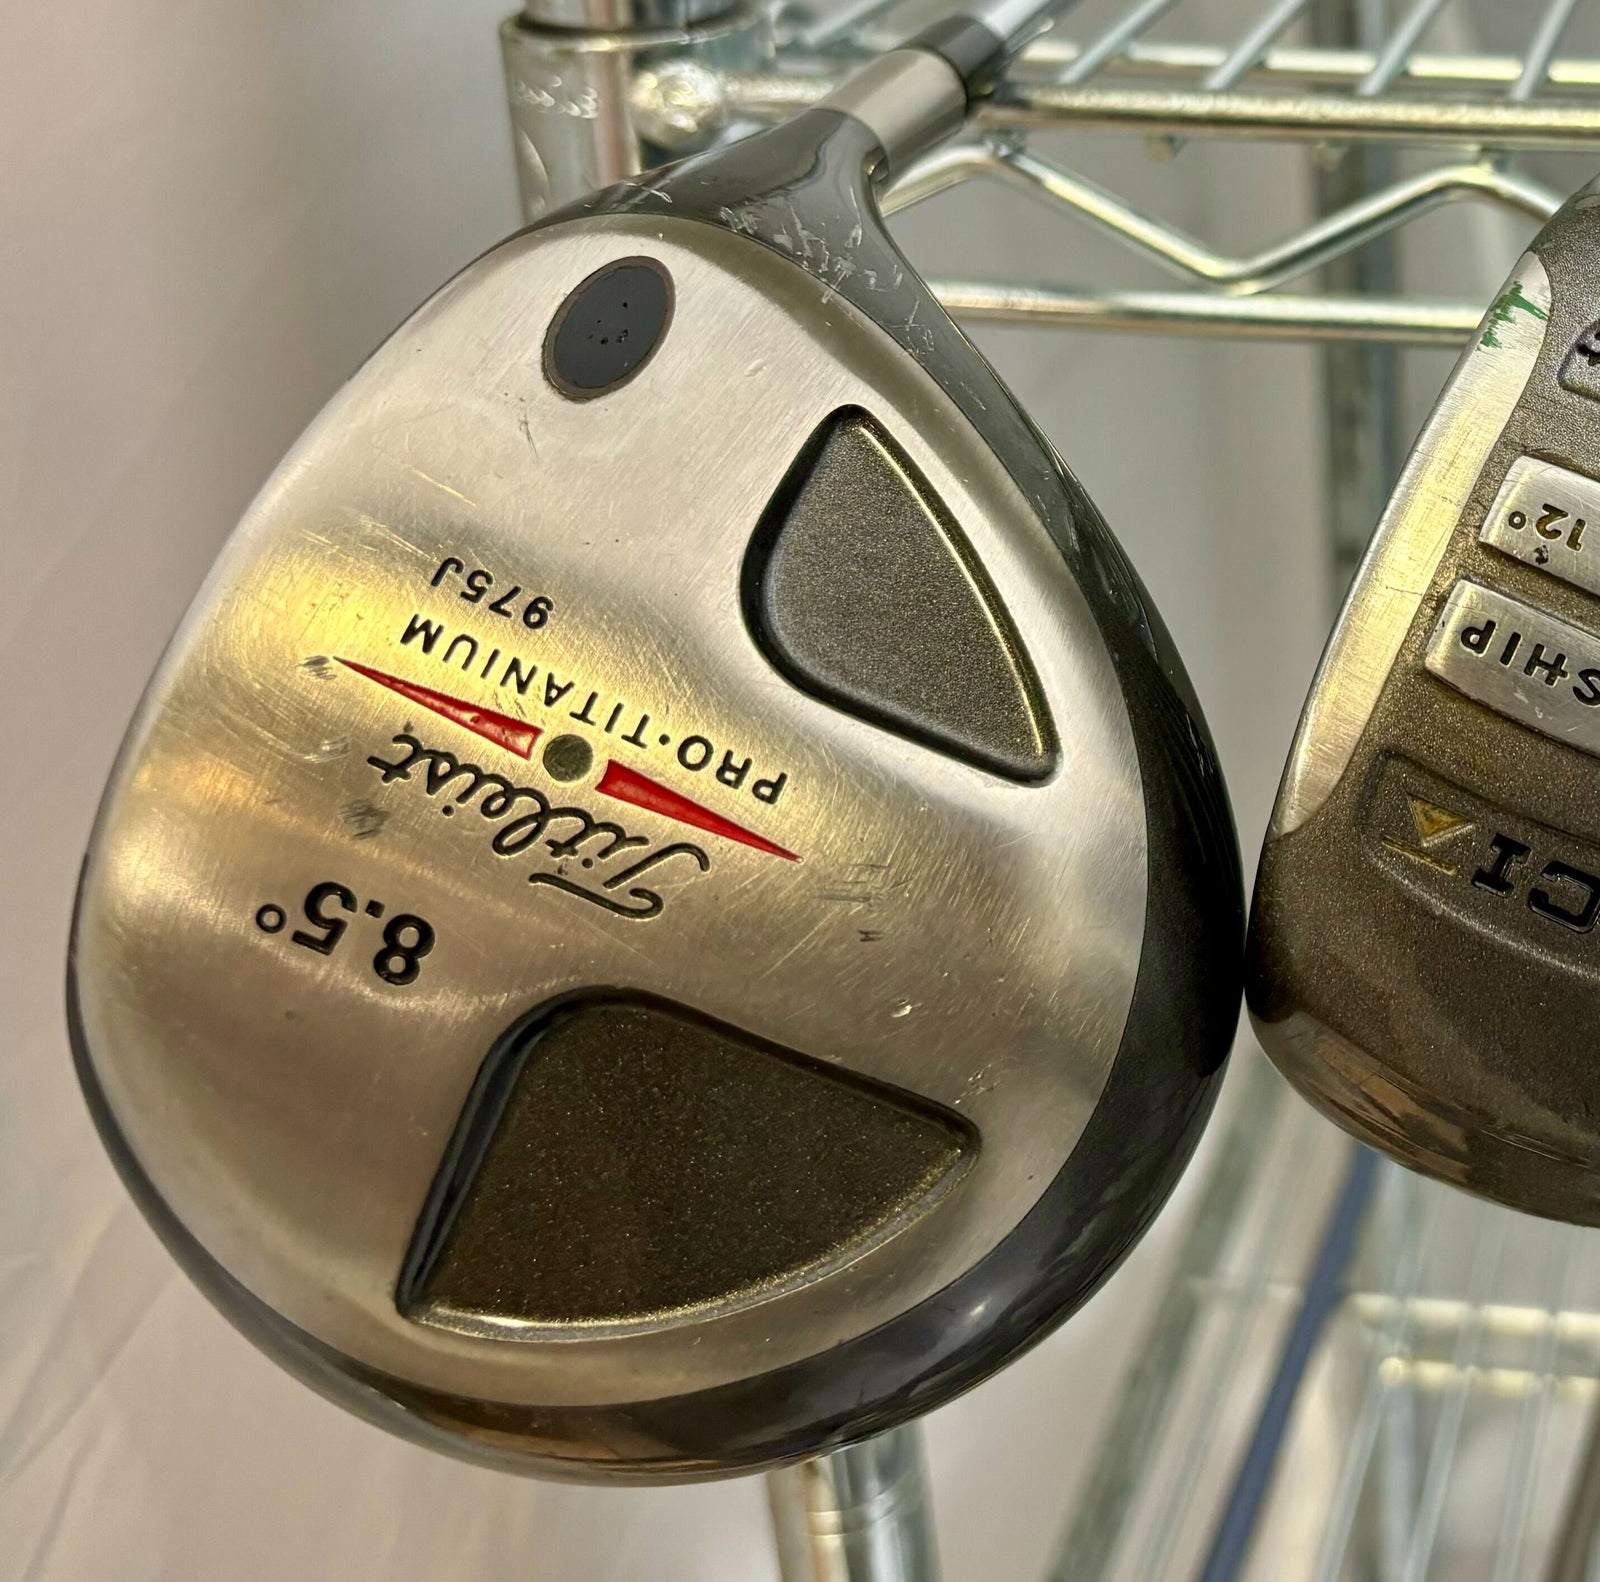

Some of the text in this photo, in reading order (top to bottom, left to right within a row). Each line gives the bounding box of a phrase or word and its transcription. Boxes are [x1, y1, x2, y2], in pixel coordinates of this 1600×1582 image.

[1507, 502, 1587, 553] 12°
[430, 556, 555, 630] 975J
[367, 733, 711, 921] Titleist
[255, 881, 435, 986] 8.5°
